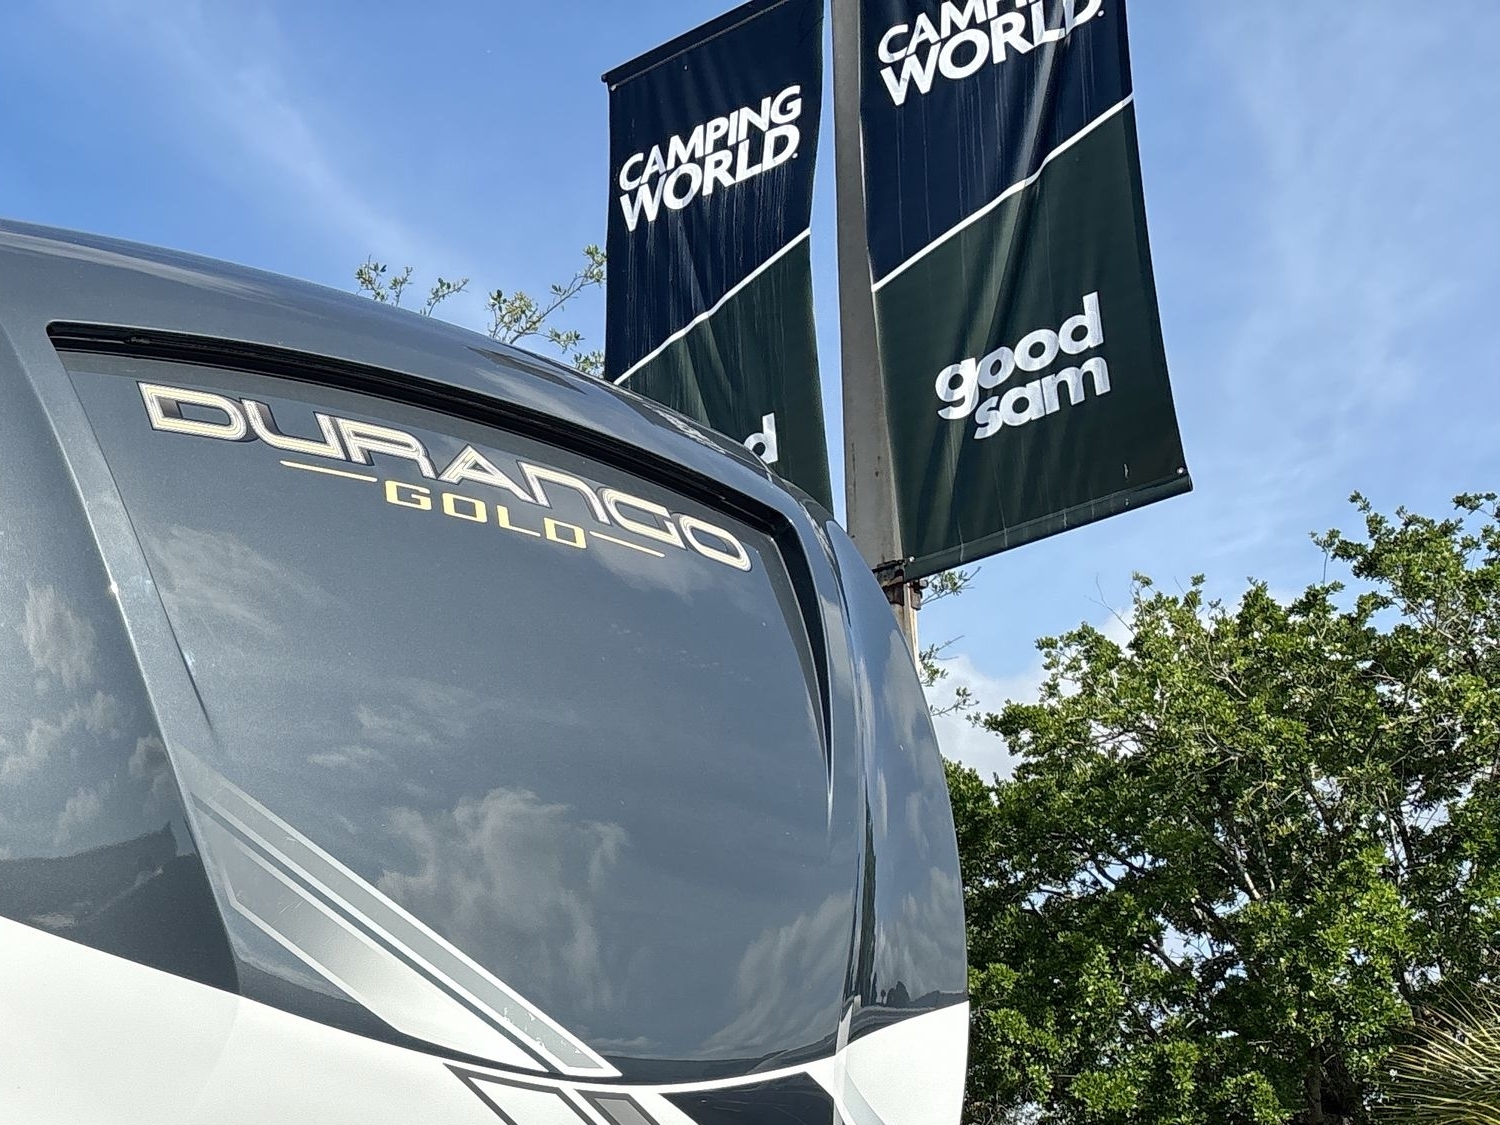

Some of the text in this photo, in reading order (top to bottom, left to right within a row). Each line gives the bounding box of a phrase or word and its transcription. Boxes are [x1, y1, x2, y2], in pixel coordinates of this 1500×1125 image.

[618, 84, 802, 192] CAMPING
[935, 291, 1104, 420] good
[974, 356, 1111, 440] sam
[136, 381, 753, 572] DURANGO
[385, 479, 588, 550] GOLD
